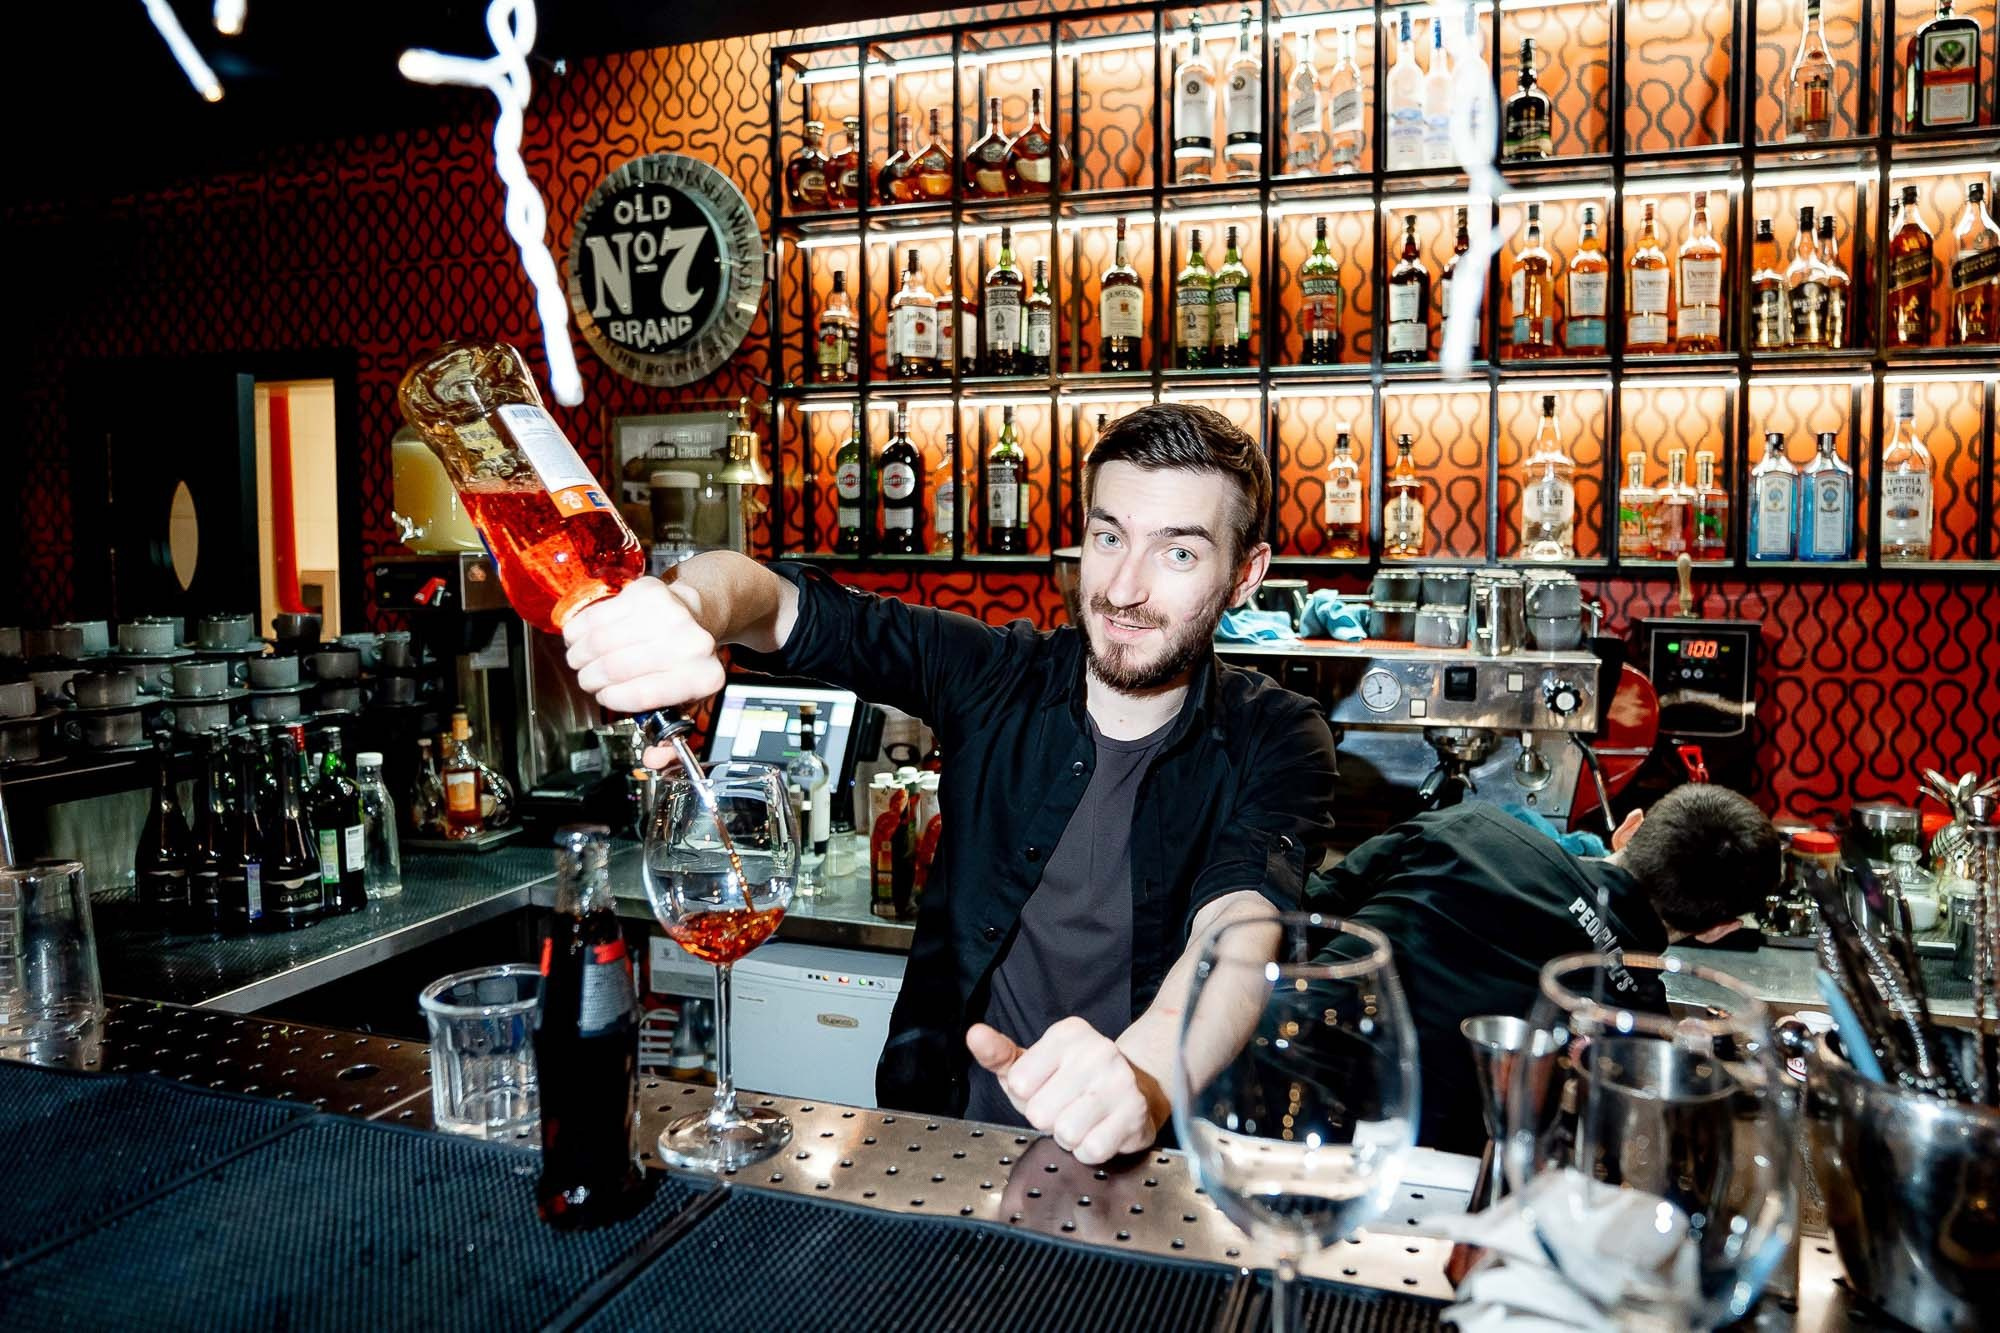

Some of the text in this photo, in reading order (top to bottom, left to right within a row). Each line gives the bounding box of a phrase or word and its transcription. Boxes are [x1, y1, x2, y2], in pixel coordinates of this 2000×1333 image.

[614, 194, 672, 224] OLD
[609, 316, 694, 349] BRAND
[1686, 640, 1718, 658] 100
